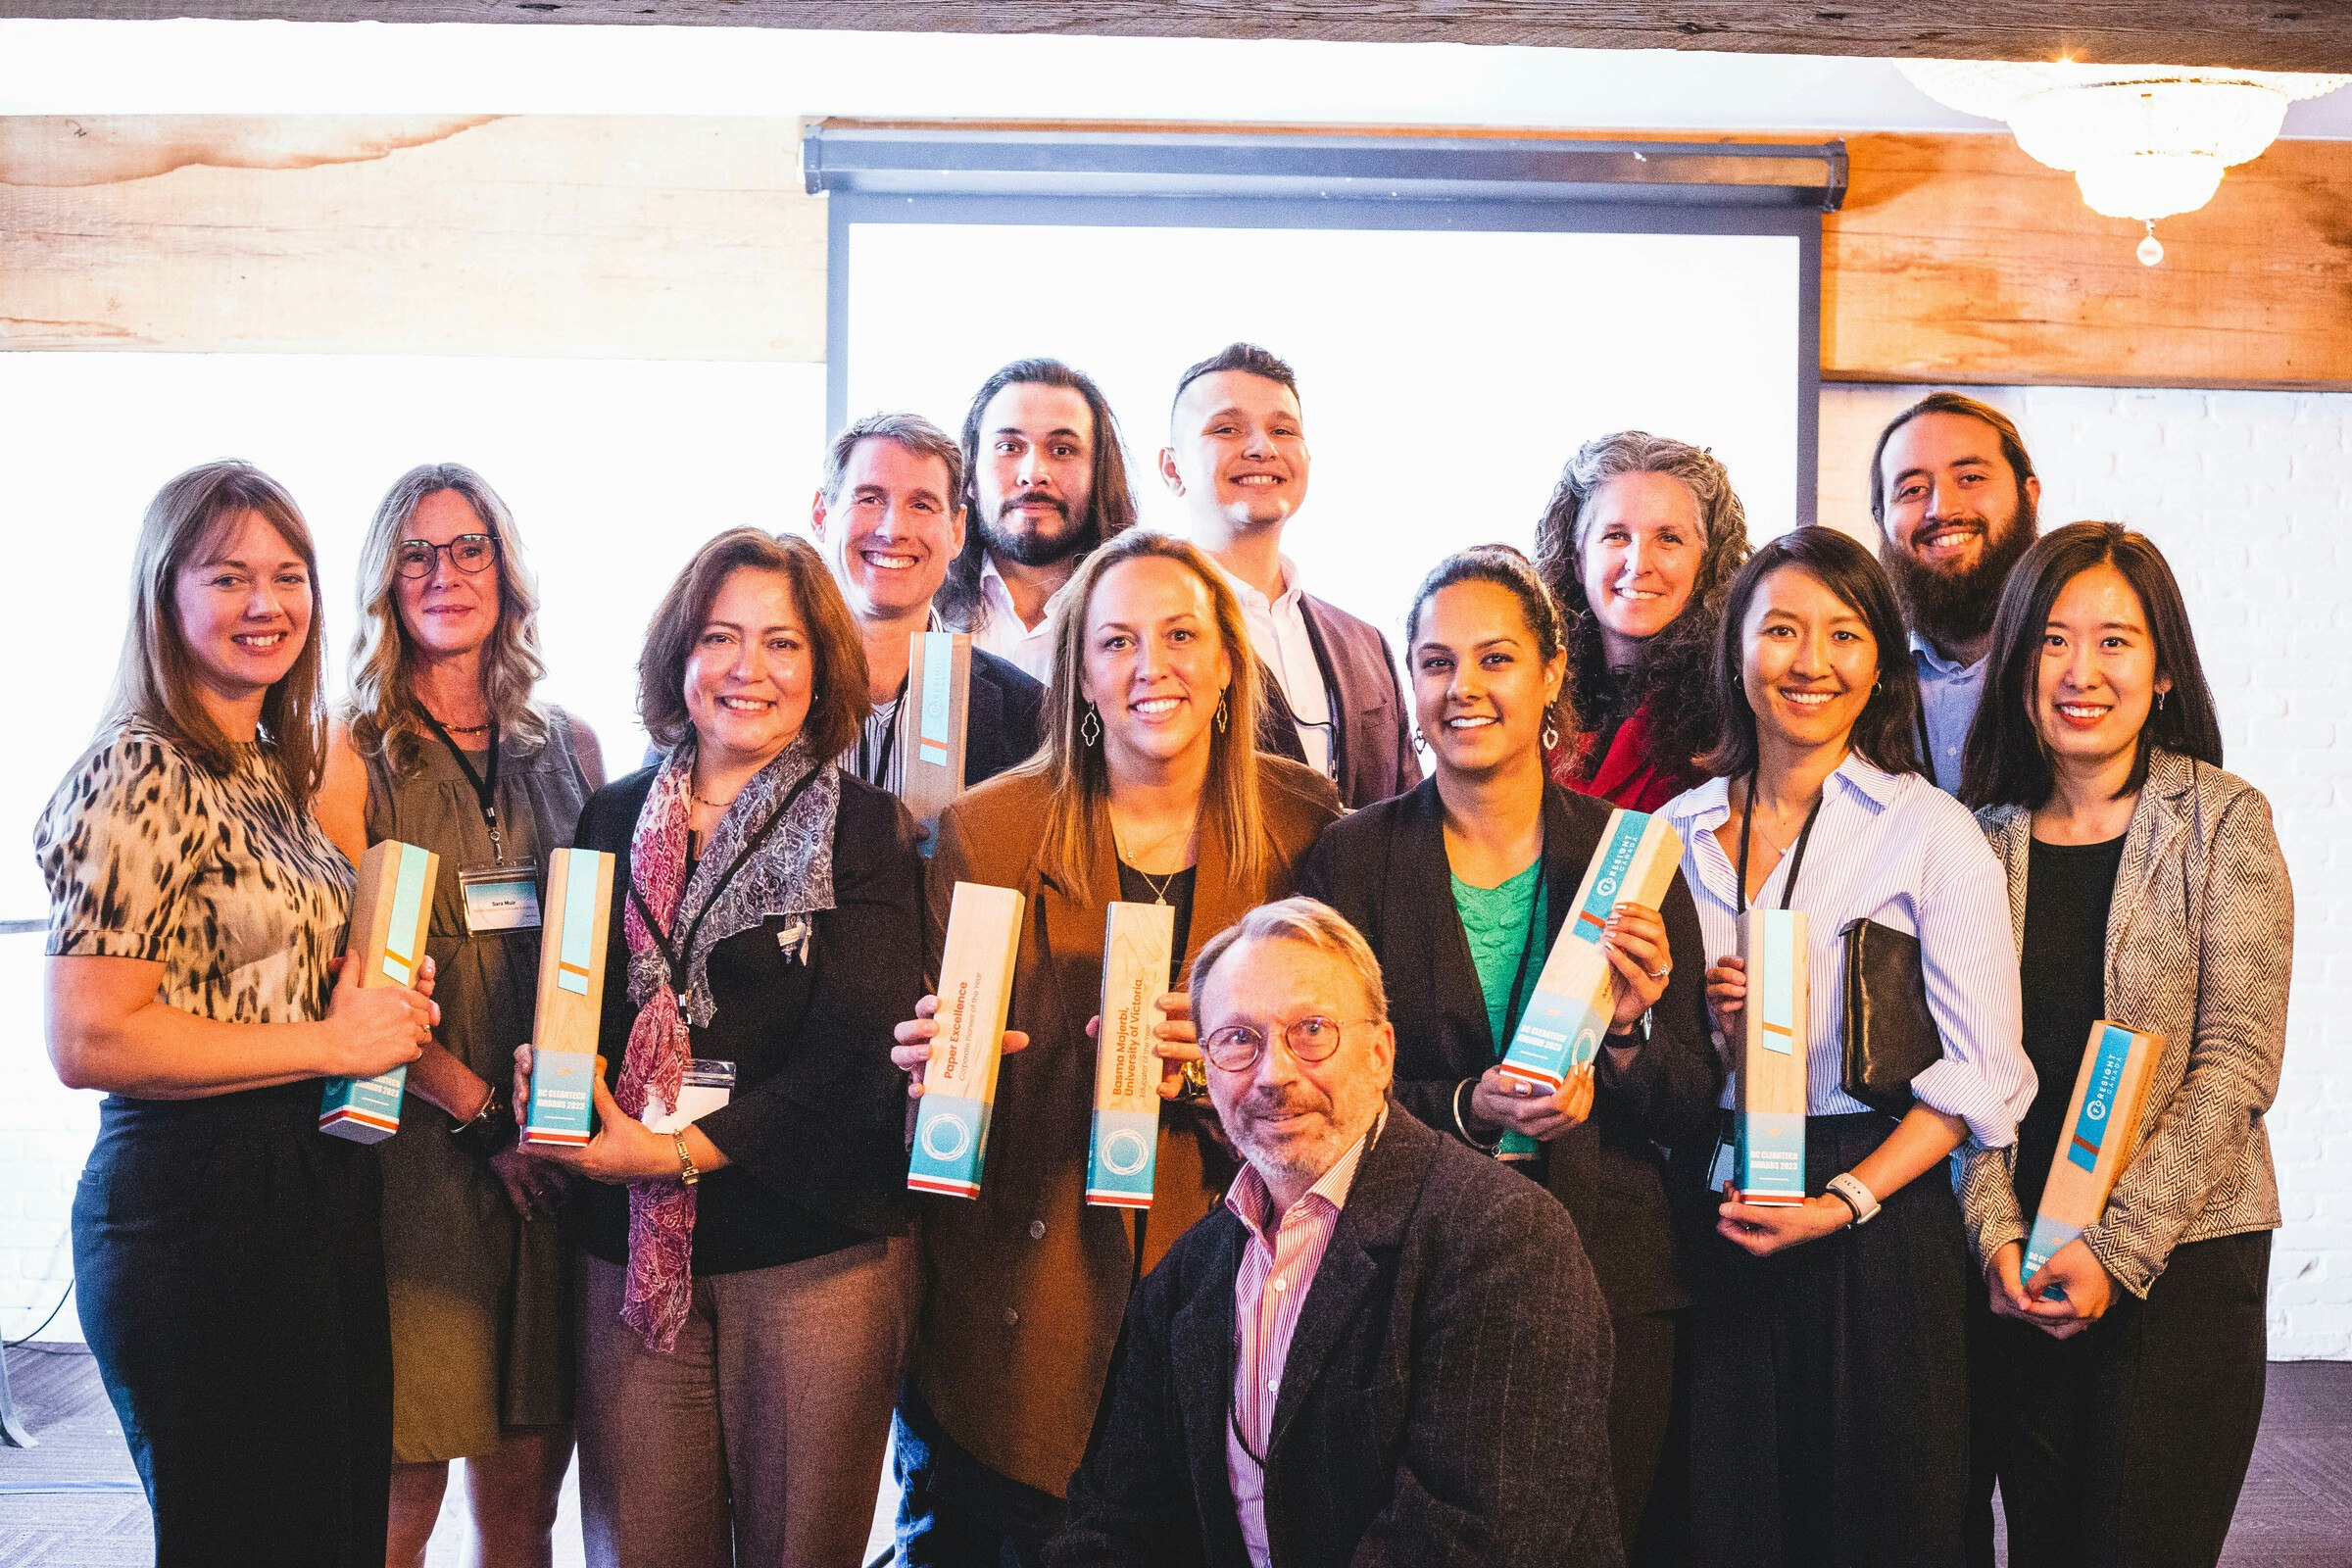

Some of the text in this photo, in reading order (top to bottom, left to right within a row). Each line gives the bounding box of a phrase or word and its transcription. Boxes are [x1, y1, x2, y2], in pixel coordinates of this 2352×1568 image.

[1600, 834, 1633, 892] FORESIGHT
[1619, 836, 1639, 872] CANADA
[944, 981, 967, 1079] Paper Excellence
[959, 1043, 970, 1081] Corporate
[965, 1014, 975, 1042] Pioneer
[1112, 1006, 1129, 1096] Basma Majerbi,
[1125, 979, 1143, 1097] University of Victoria
[549, 1089, 586, 1100] CLEANTECH
[2090, 1054, 2116, 1116] FORESIGHT
[2106, 1056, 2123, 1095] CANADA
[566, 1101, 585, 1110] 2023
[1750, 1160, 1798, 1170] AWARDS 2023
[1761, 1151, 1798, 1159] CLEANTECH
